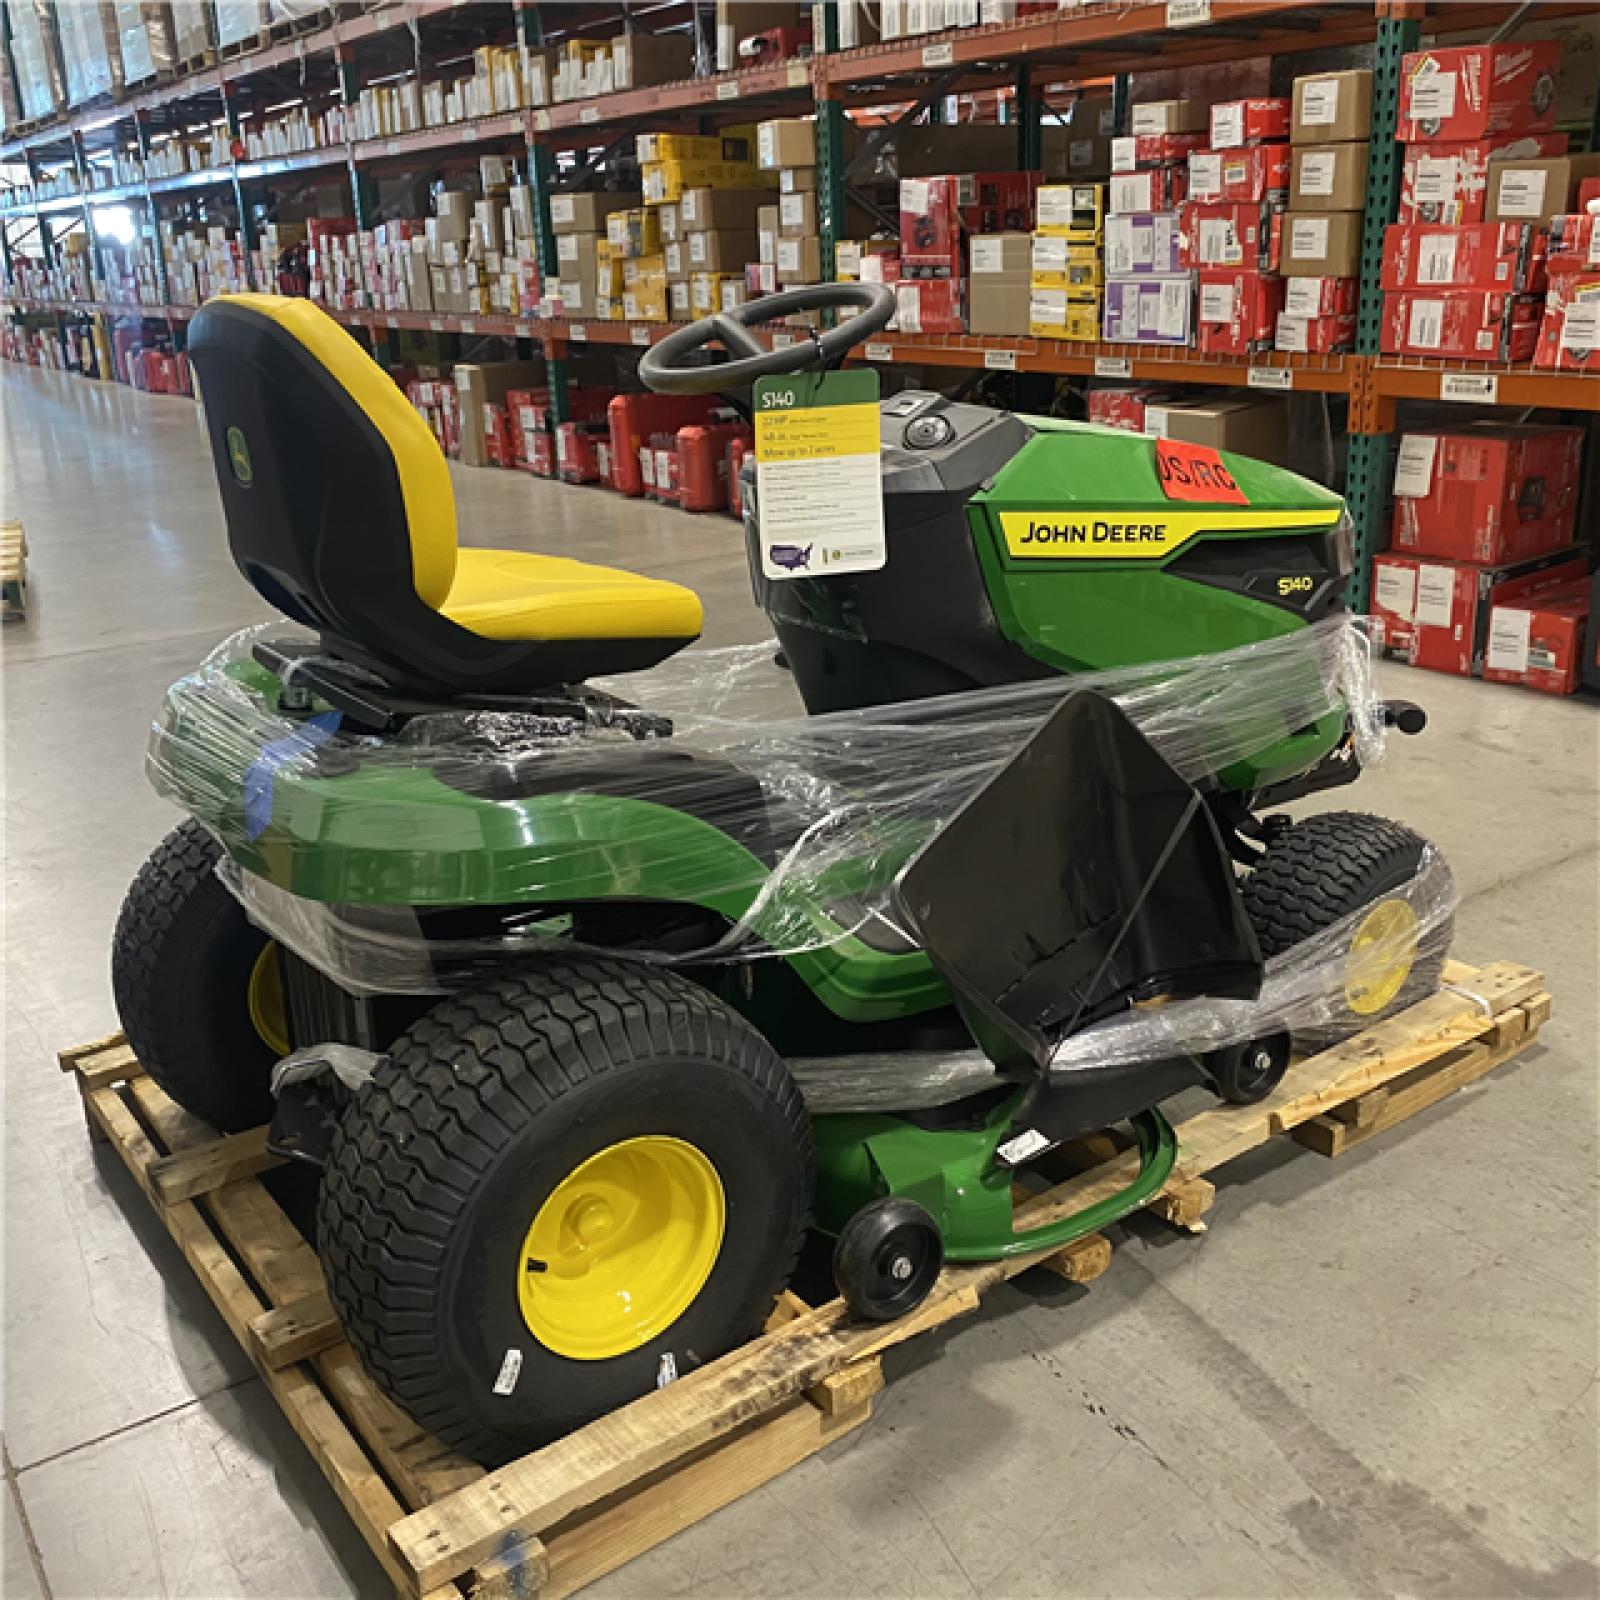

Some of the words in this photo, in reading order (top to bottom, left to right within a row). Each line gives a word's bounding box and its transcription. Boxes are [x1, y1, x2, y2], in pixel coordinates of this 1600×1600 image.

[762, 390, 795, 408] S140
[1020, 522, 1086, 543] JOHN
[1092, 522, 1167, 543] DEERE
[1277, 576, 1313, 596] S140
